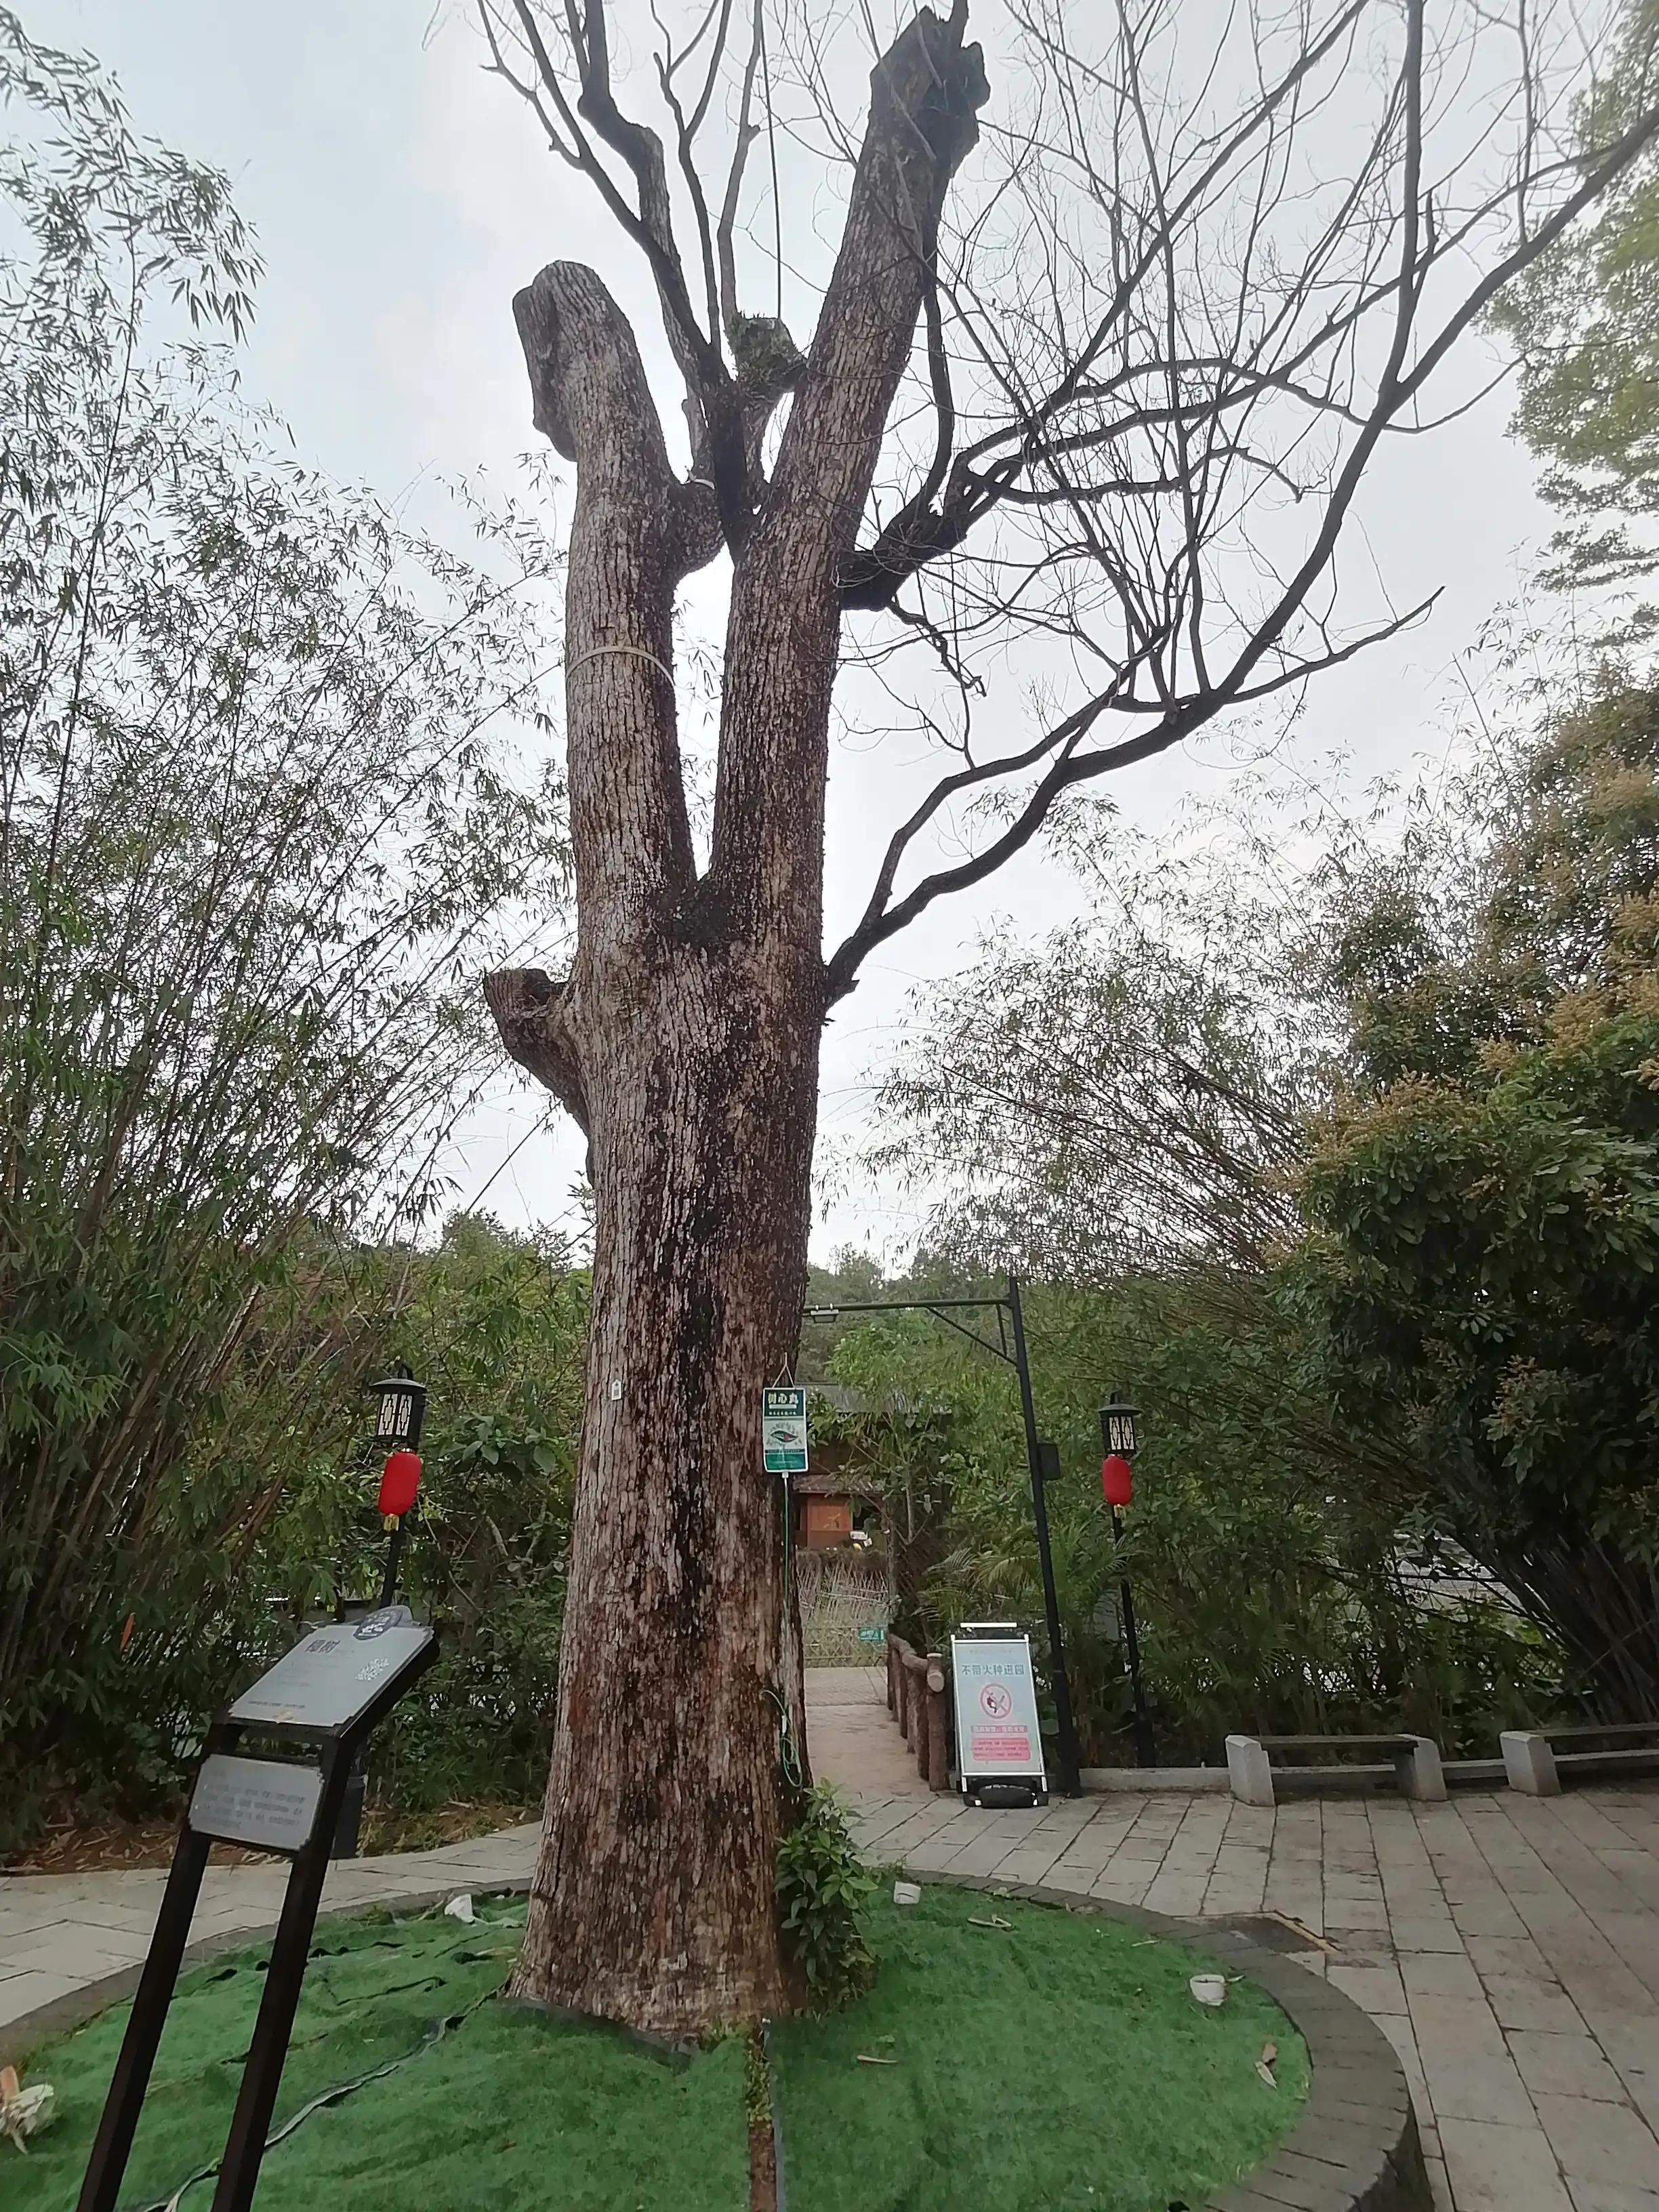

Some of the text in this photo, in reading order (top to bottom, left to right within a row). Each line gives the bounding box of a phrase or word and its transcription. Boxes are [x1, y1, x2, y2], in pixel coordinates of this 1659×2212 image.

[961, 1664, 1025, 1675] 不带火种进园
